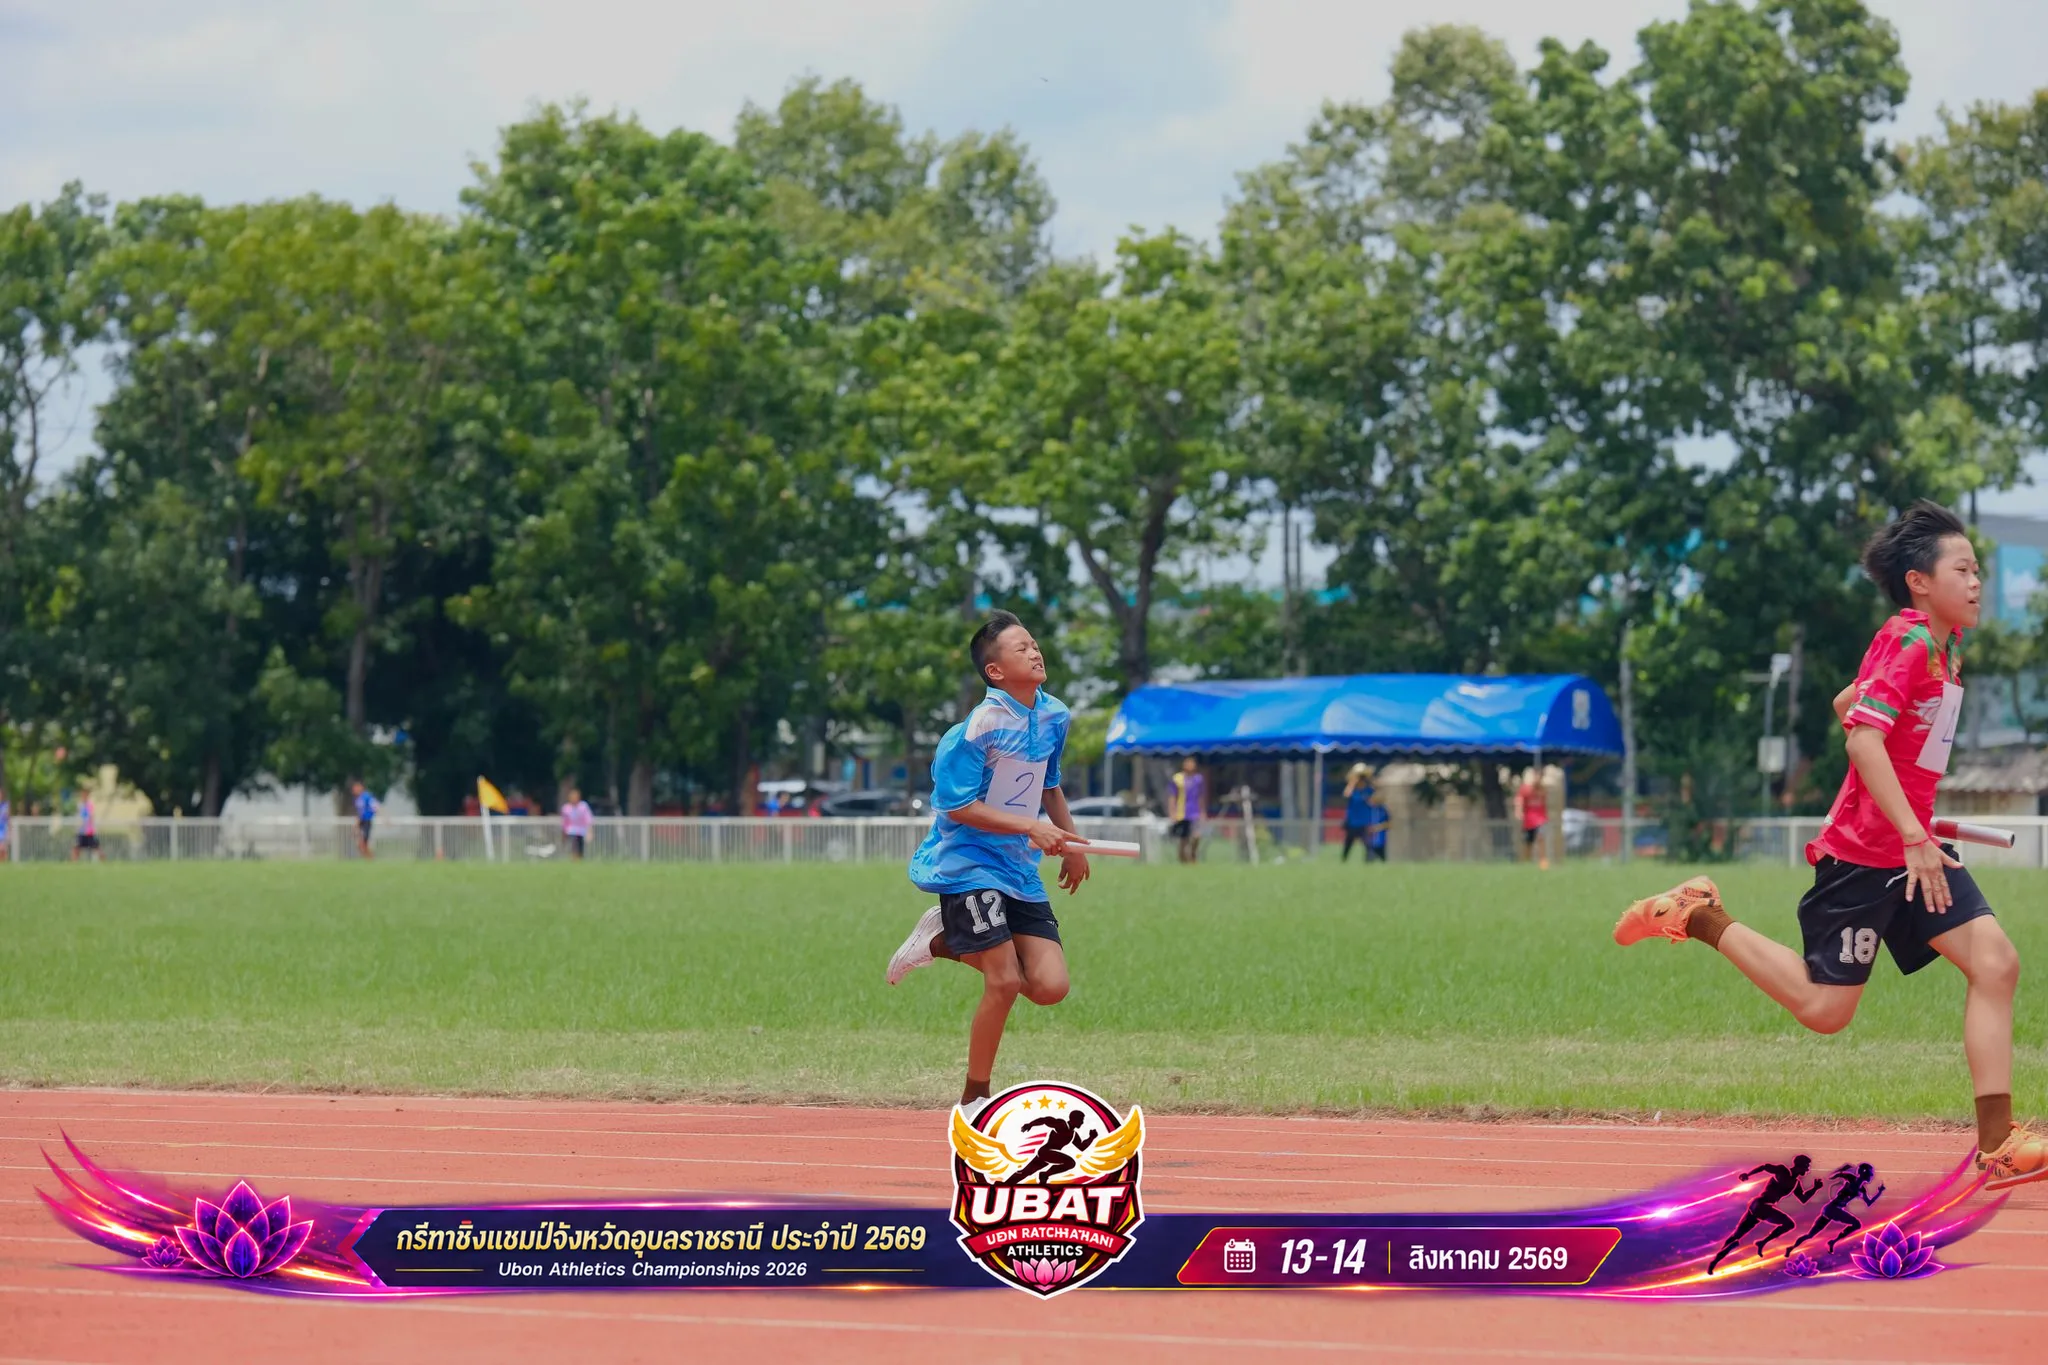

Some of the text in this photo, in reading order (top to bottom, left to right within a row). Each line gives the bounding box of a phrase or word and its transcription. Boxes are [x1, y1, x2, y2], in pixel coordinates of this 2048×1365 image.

[1004, 772, 1035, 807] 2
[965, 889, 1008, 935] 12
[1839, 926, 1878, 965] 18
